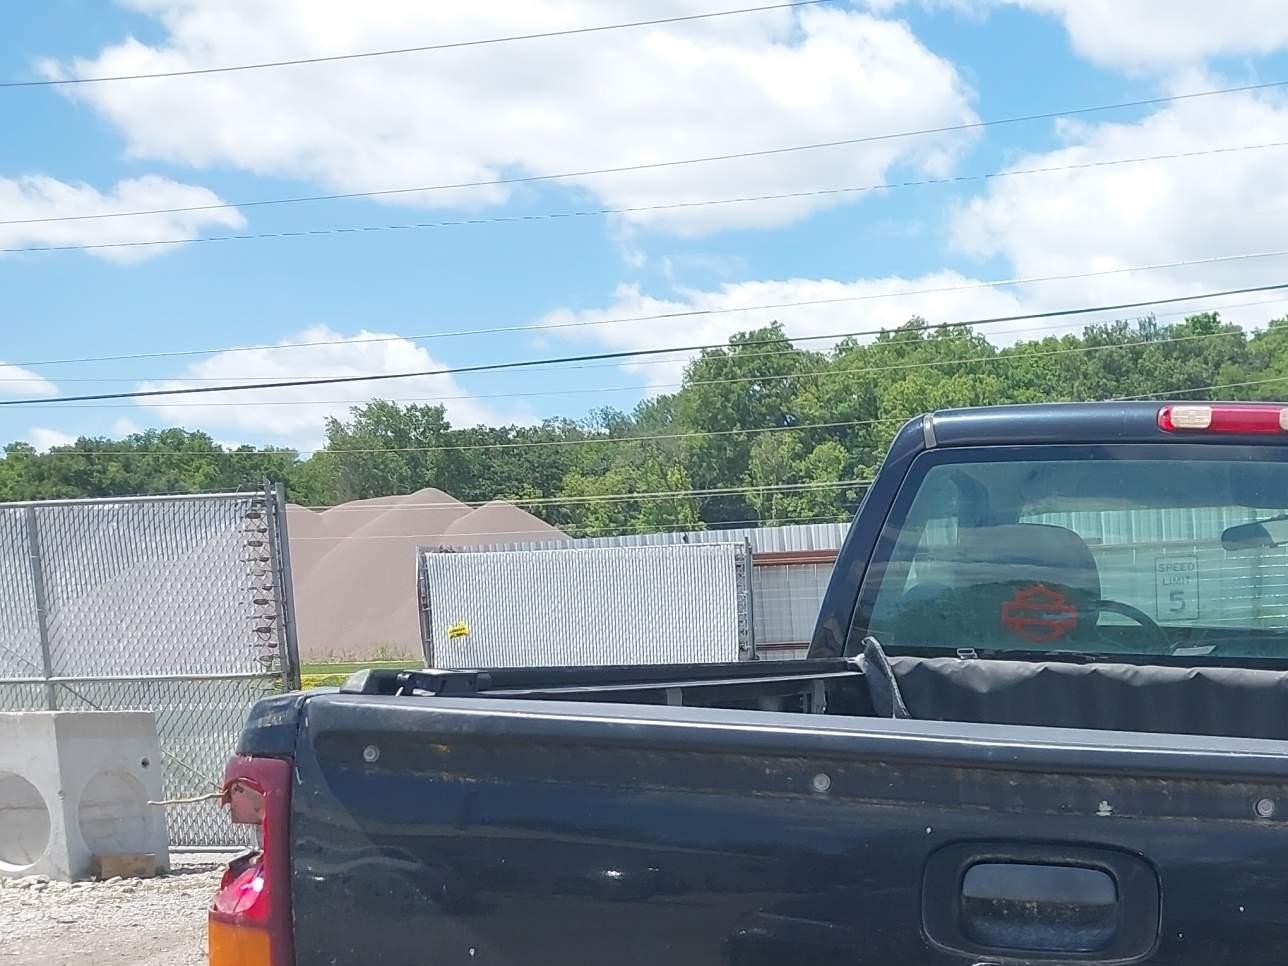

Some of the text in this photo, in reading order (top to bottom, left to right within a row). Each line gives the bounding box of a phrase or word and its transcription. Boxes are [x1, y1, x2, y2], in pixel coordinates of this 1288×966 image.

[1158, 562, 1194, 572] SPEED
[1162, 575, 1191, 585] LIMIT
[1169, 591, 1186, 612] 5
